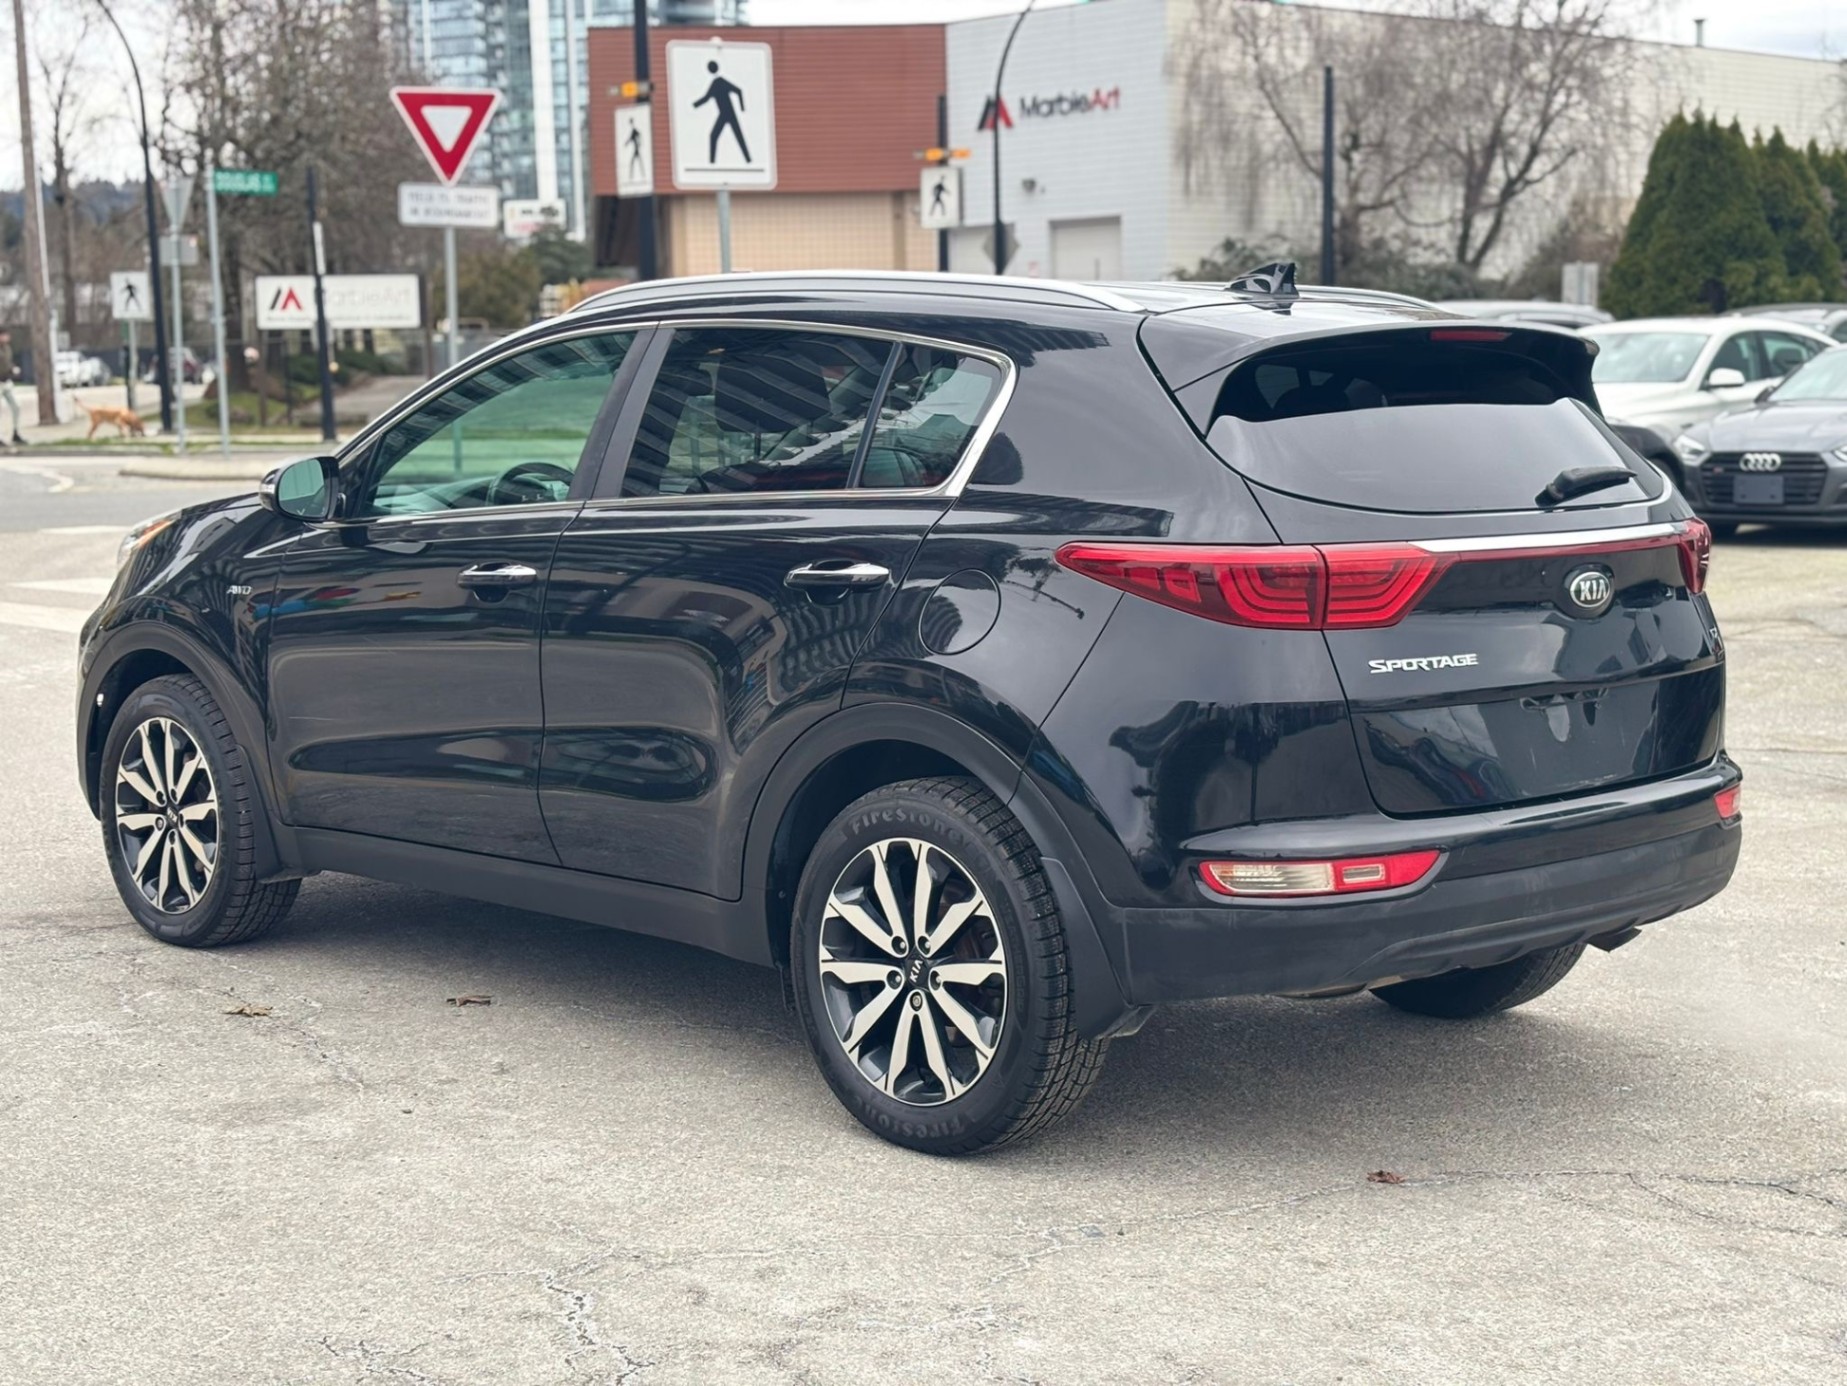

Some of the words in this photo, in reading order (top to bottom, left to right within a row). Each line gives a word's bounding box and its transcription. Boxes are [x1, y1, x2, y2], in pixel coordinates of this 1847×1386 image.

[1019, 85, 1121, 117] MarbleArt
[1579, 578, 1607, 601] KIA
[1368, 653, 1479, 674] SPORTAGE
[909, 959, 924, 983] KIA
